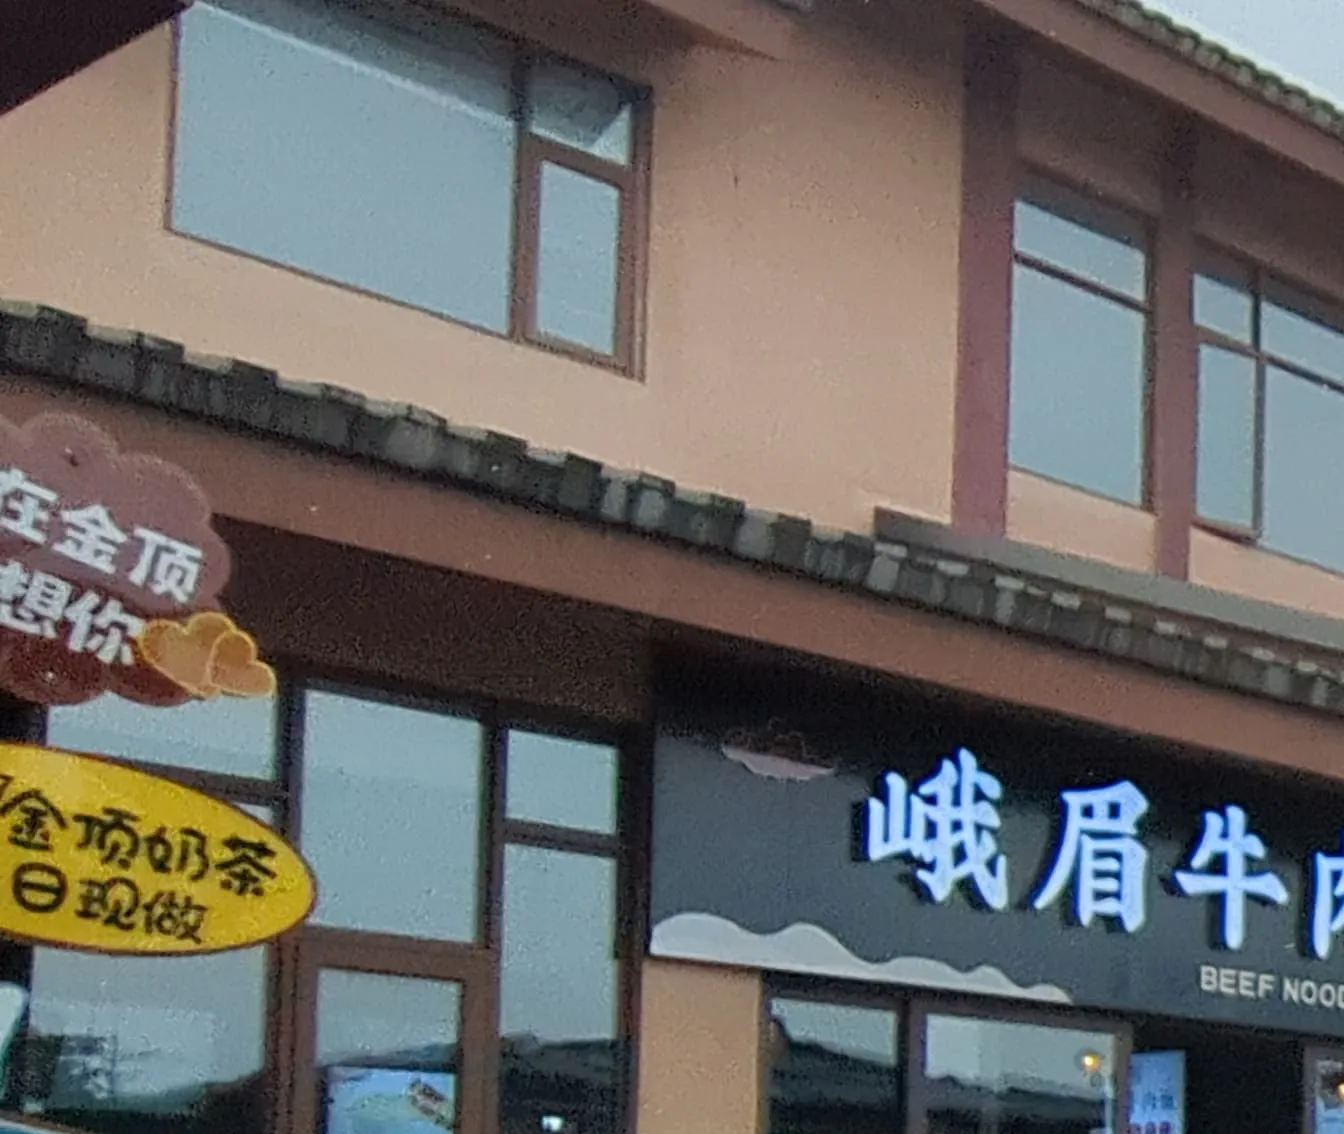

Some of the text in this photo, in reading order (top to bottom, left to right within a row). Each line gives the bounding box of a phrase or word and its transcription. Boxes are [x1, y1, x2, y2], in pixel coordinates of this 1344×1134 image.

[0, 468, 203, 602] 在金顶
[0, 560, 146, 666] 想你
[0, 774, 278, 897] 金顶奶茶
[12, 861, 208, 943] 日现做
[1200, 964, 1276, 999] BEEF
